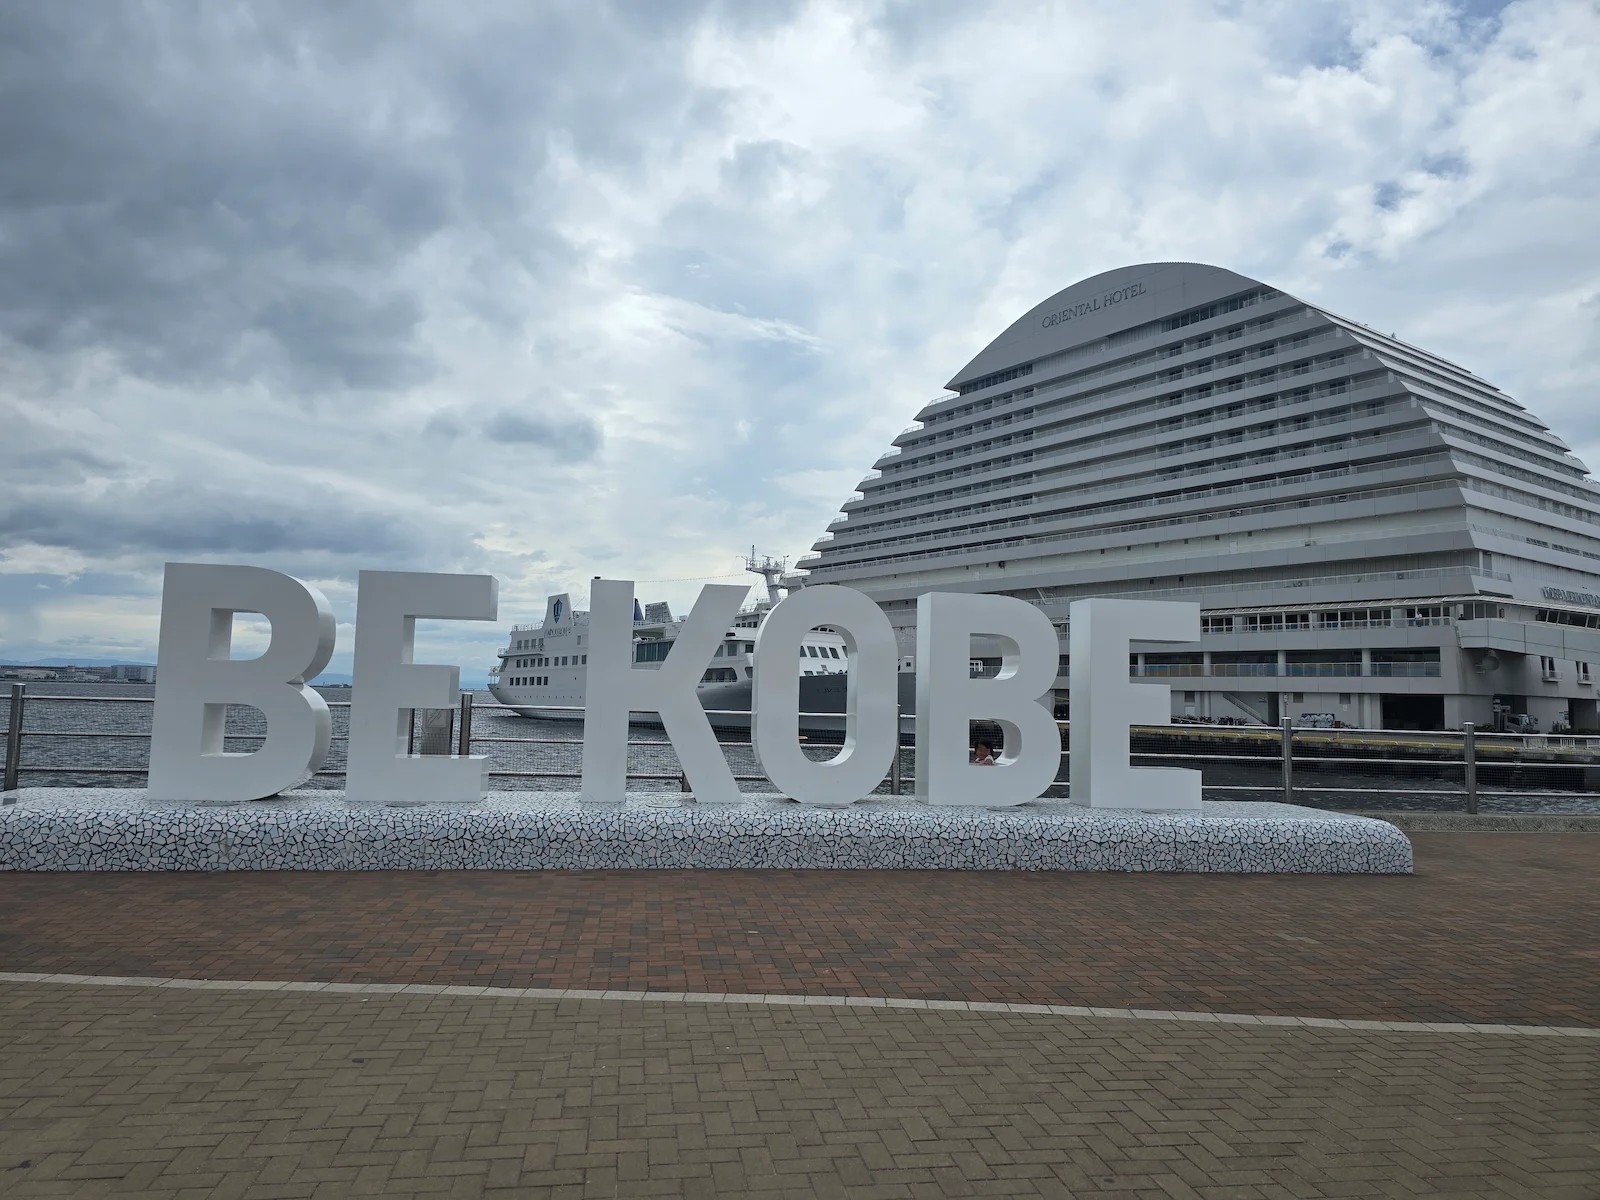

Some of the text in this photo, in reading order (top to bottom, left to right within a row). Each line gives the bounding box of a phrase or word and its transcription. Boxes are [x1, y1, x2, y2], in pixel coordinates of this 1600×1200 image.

[1041, 282, 1147, 329] ORIENTAL HOTEL
[147, 562, 1204, 808] BE KOBE
